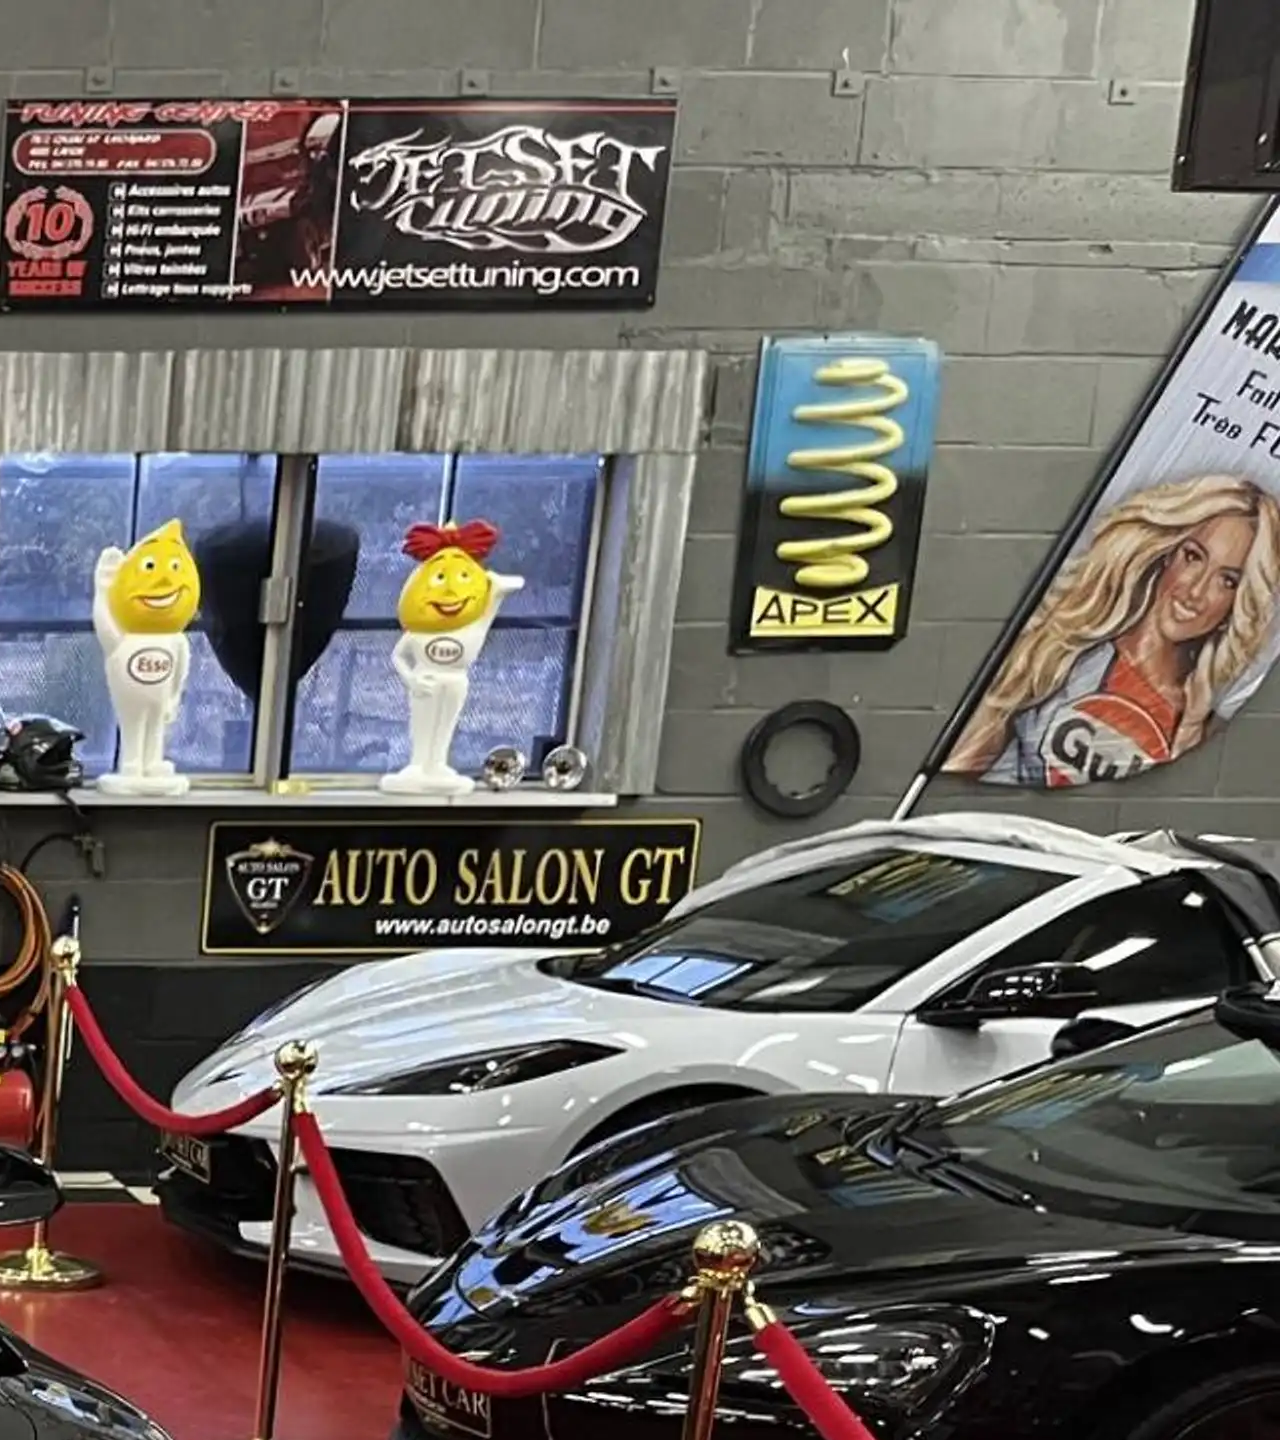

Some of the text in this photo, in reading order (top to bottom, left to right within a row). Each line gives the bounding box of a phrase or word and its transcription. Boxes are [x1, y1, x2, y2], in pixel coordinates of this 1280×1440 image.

[27, 203, 75, 241] 10
[290, 260, 640, 297] www.jetsettuning.com
[755, 589, 890, 625] APEX
[137, 655, 173, 673] Esso
[430, 645, 459, 657] Esso
[246, 877, 290, 900] GT
[313, 845, 685, 906] AUTO SALON GT
[375, 912, 611, 940] www.autosalongt.be
